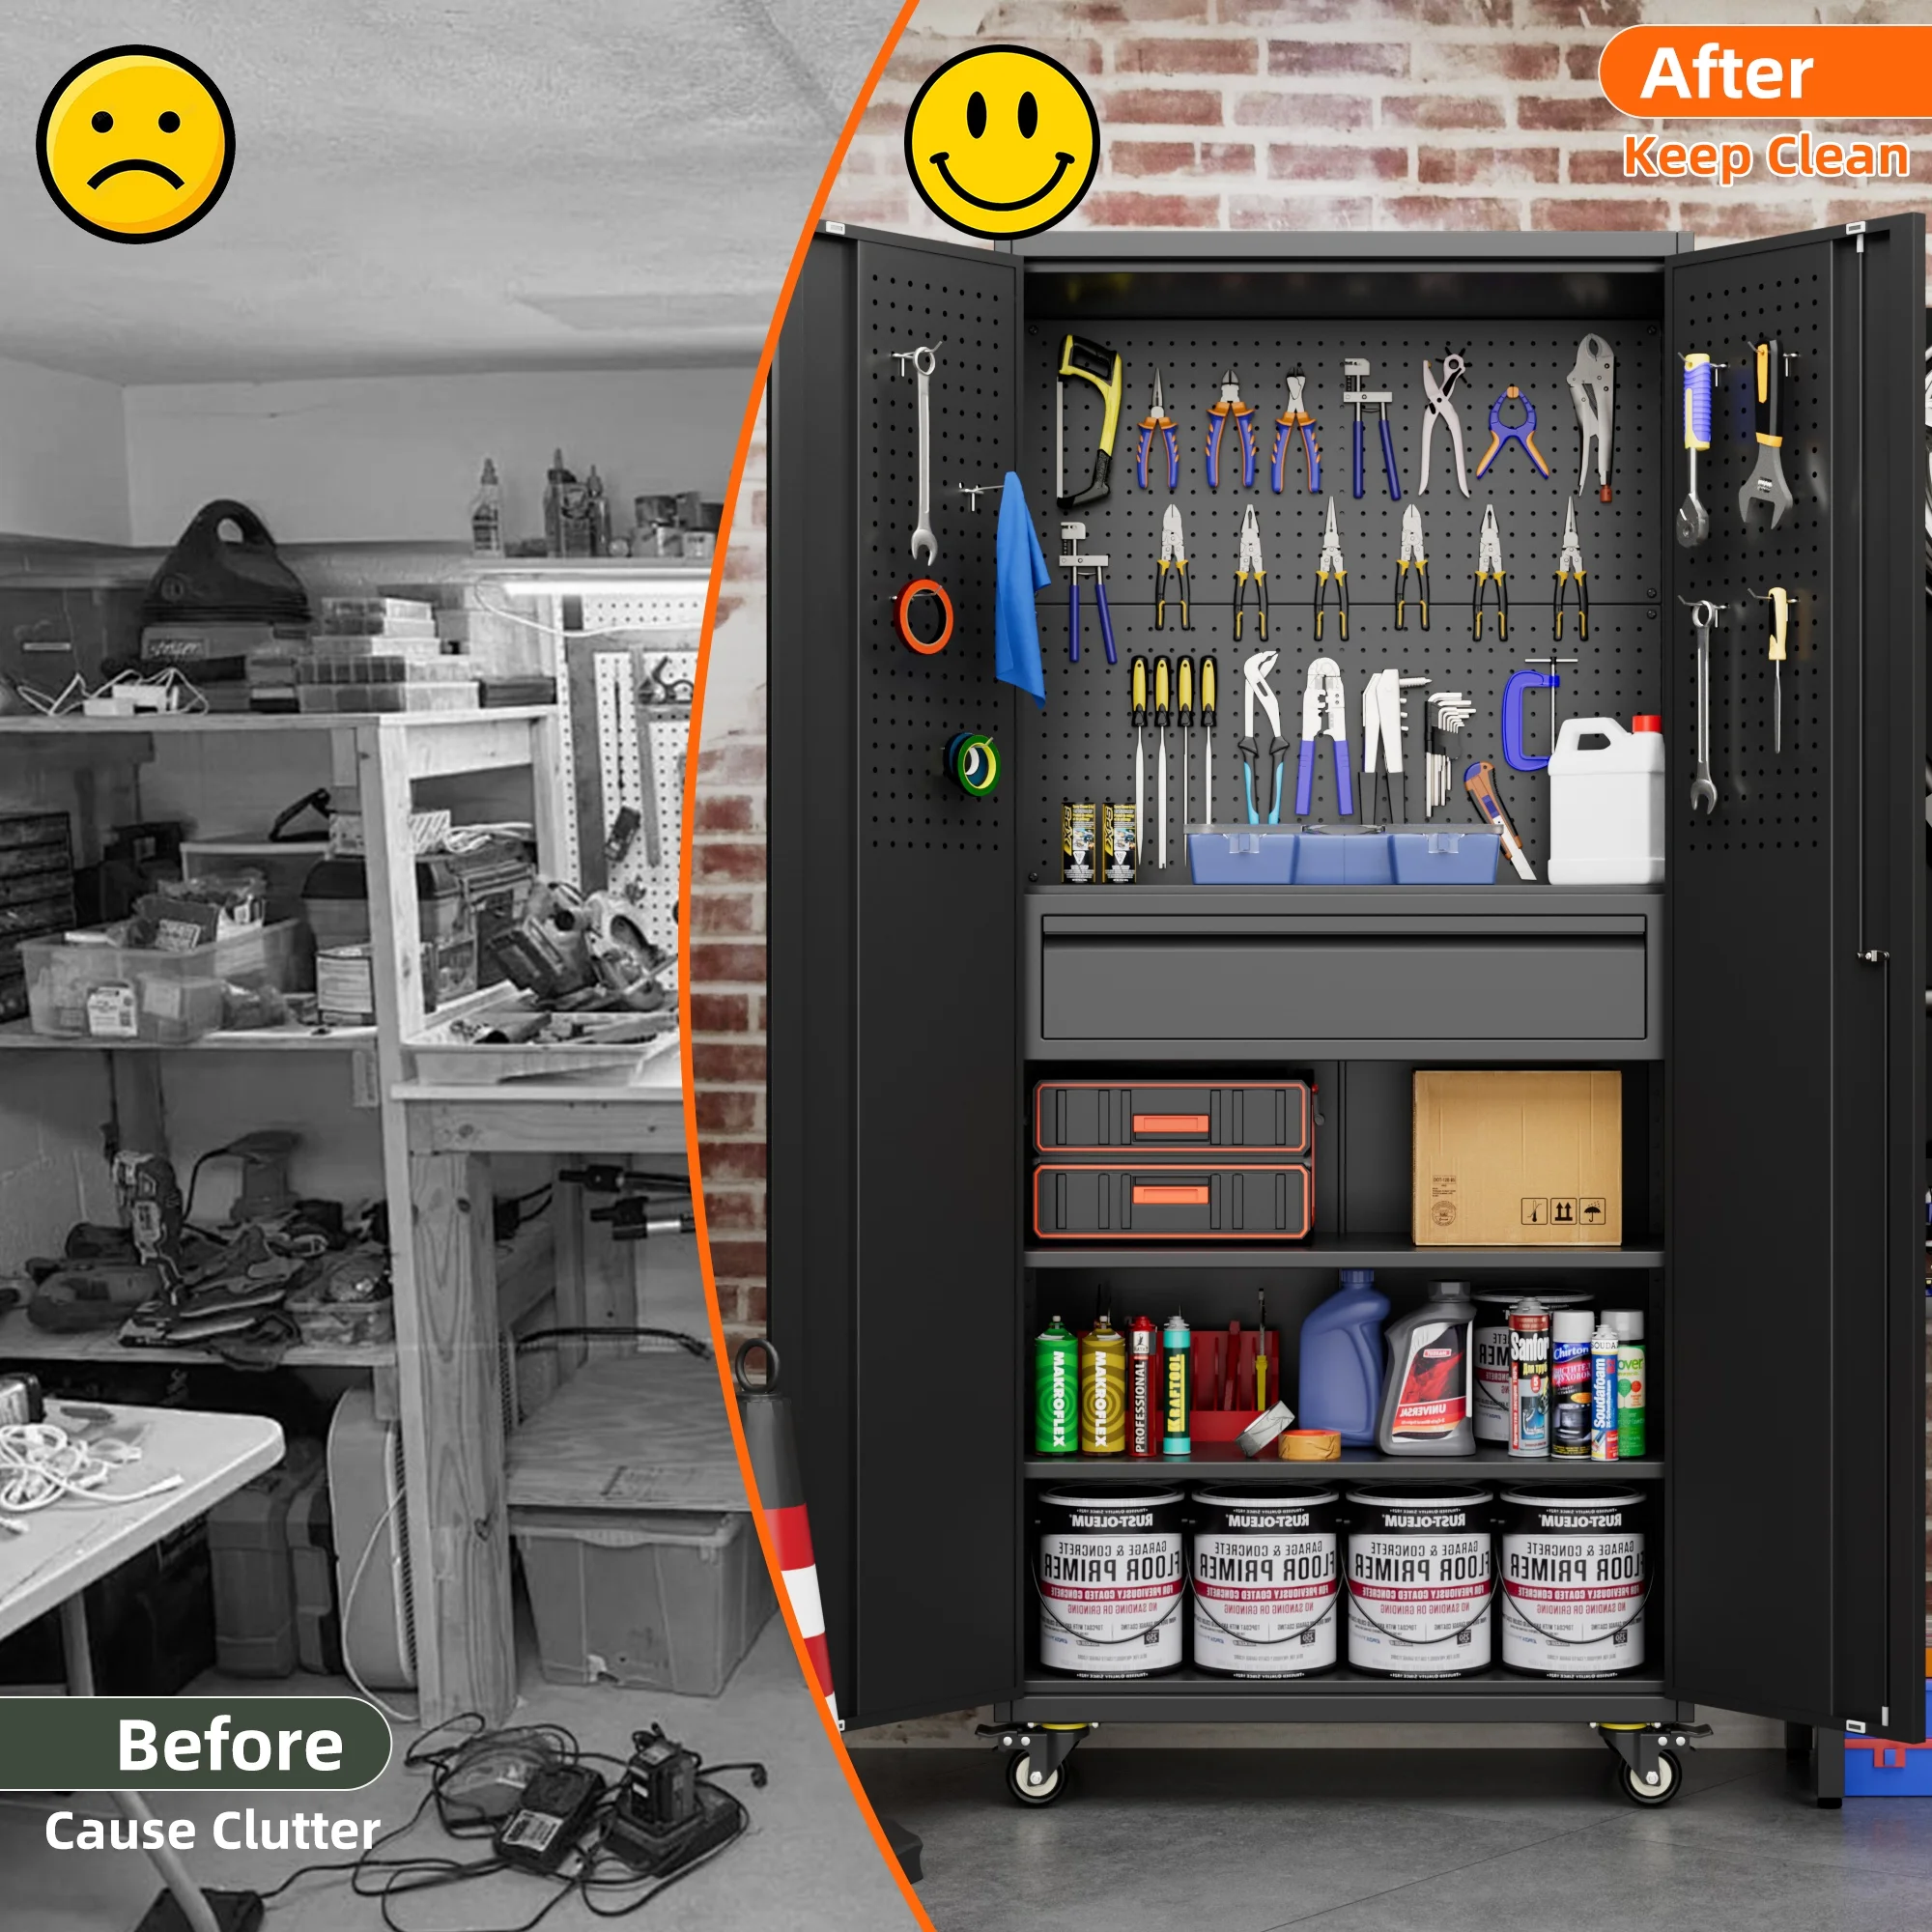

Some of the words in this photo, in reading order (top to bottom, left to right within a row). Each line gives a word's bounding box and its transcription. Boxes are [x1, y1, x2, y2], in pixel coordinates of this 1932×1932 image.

[1511, 1332, 1549, 1361] Sanfor
[1553, 1346, 1589, 1360] Chirton
[1053, 1350, 1065, 1447] MAKROFLEX
[1094, 1350, 1107, 1447] MAKROFLEX
[1135, 1361, 1145, 1453] PROFESSIONAL
[1167, 1353, 1180, 1433] KRAFTOOL
[1594, 1358, 1605, 1428] Soudafoam
